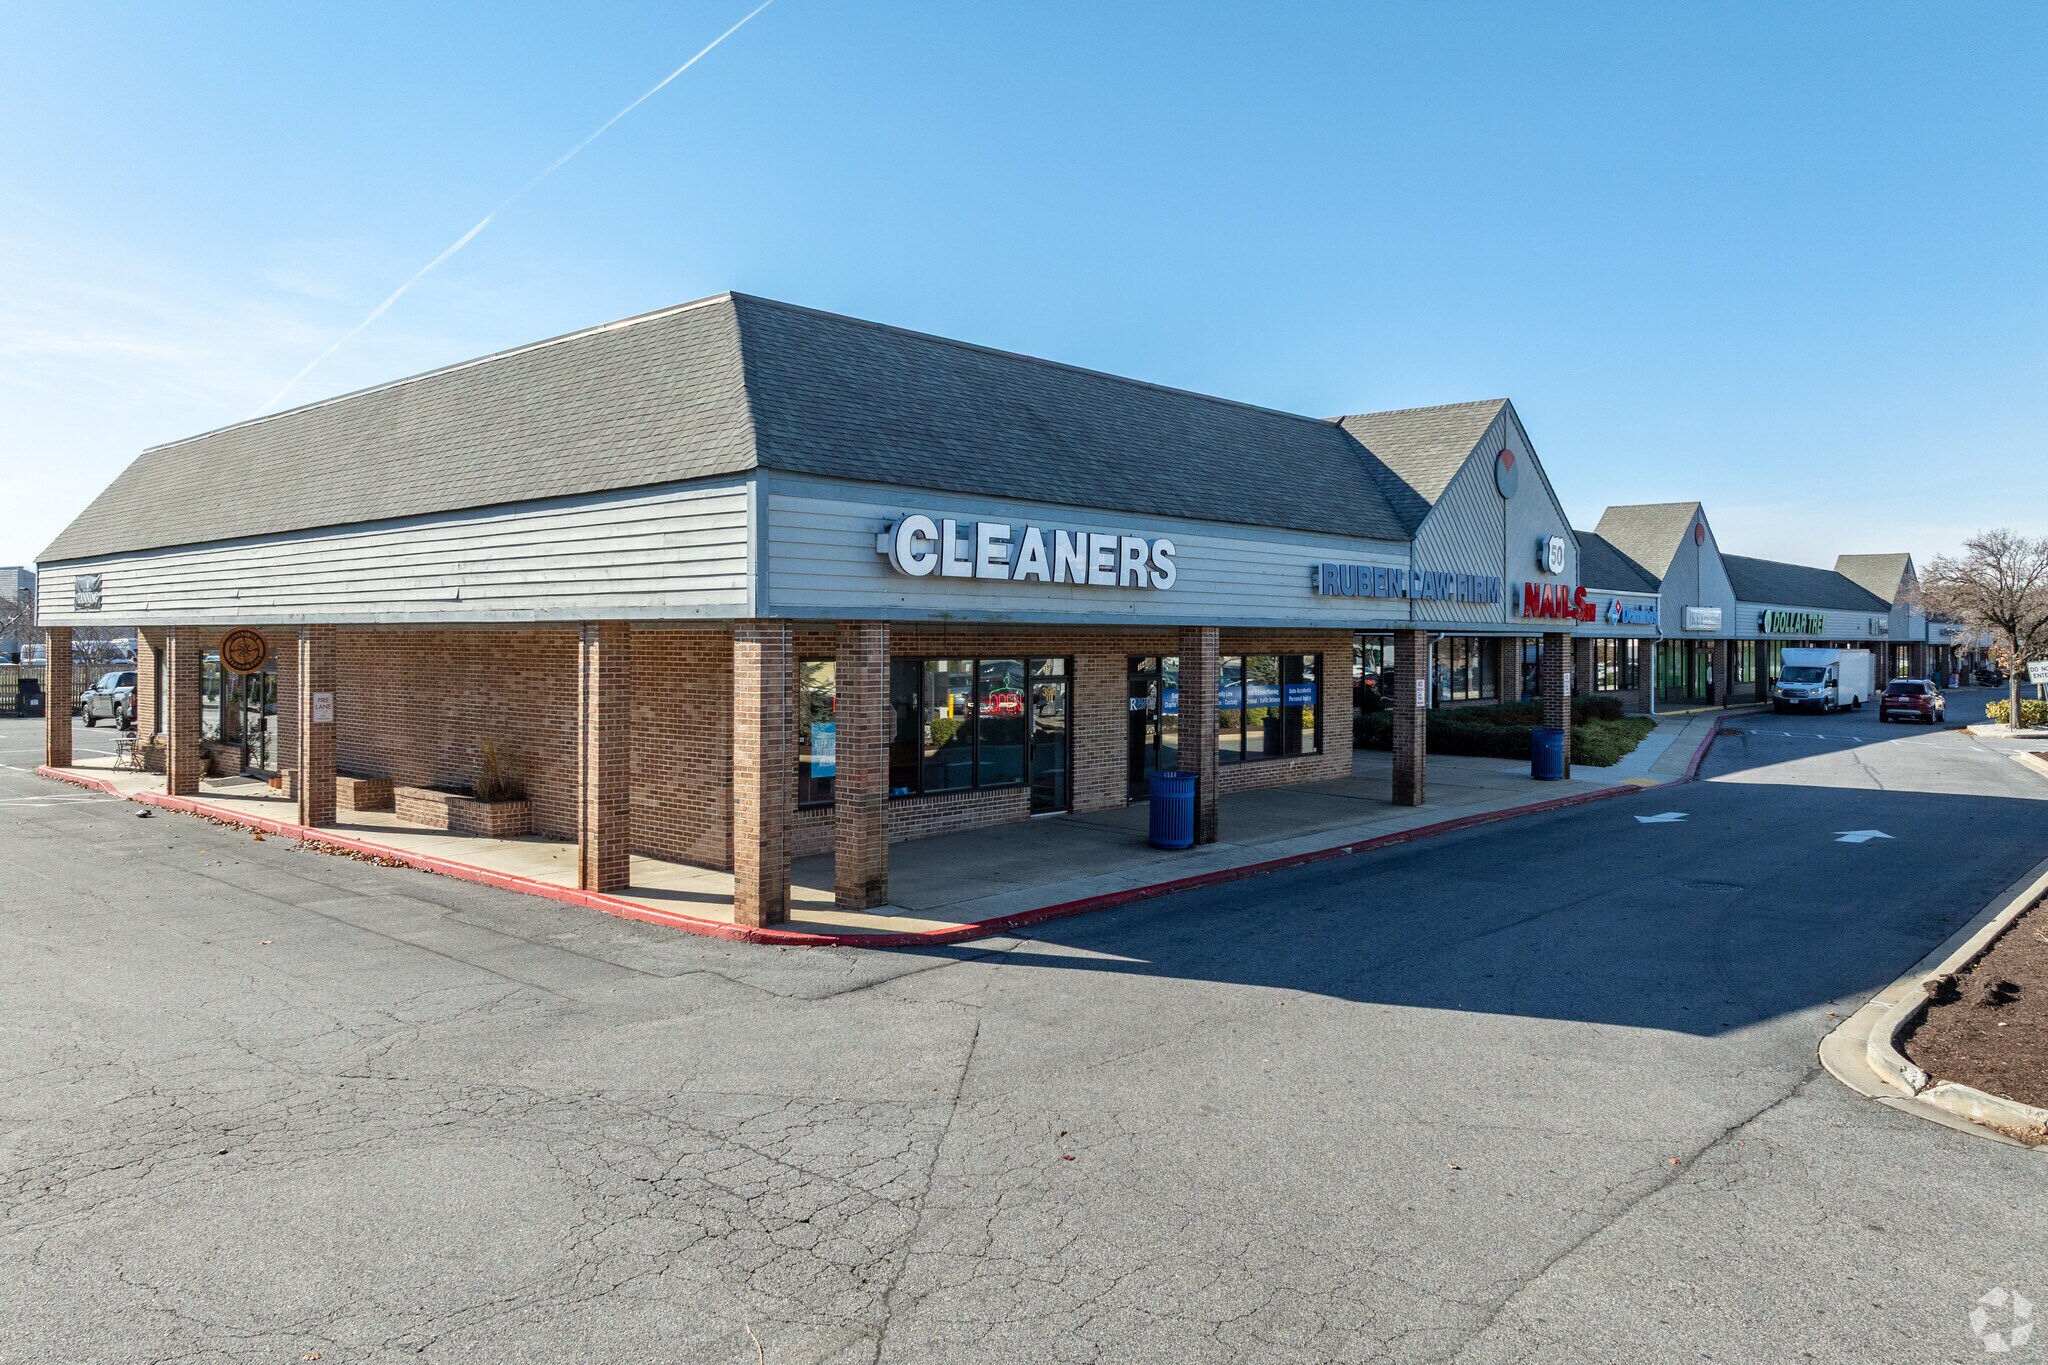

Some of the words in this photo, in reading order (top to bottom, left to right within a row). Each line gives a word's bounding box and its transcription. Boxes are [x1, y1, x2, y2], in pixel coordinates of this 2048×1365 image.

[892, 513, 1178, 591] CLEANERS
[1550, 544, 1563, 567] 50
[1321, 563, 1402, 598] RUBEN
[1408, 569, 1451, 601] LAW
[1456, 573, 1501, 604] FIRM
[1523, 582, 1587, 622] NAILS
[1773, 611, 1807, 634] DOLLAR
[1808, 613, 1826, 634] TREE
[989, 693, 1022, 713] OPEN
